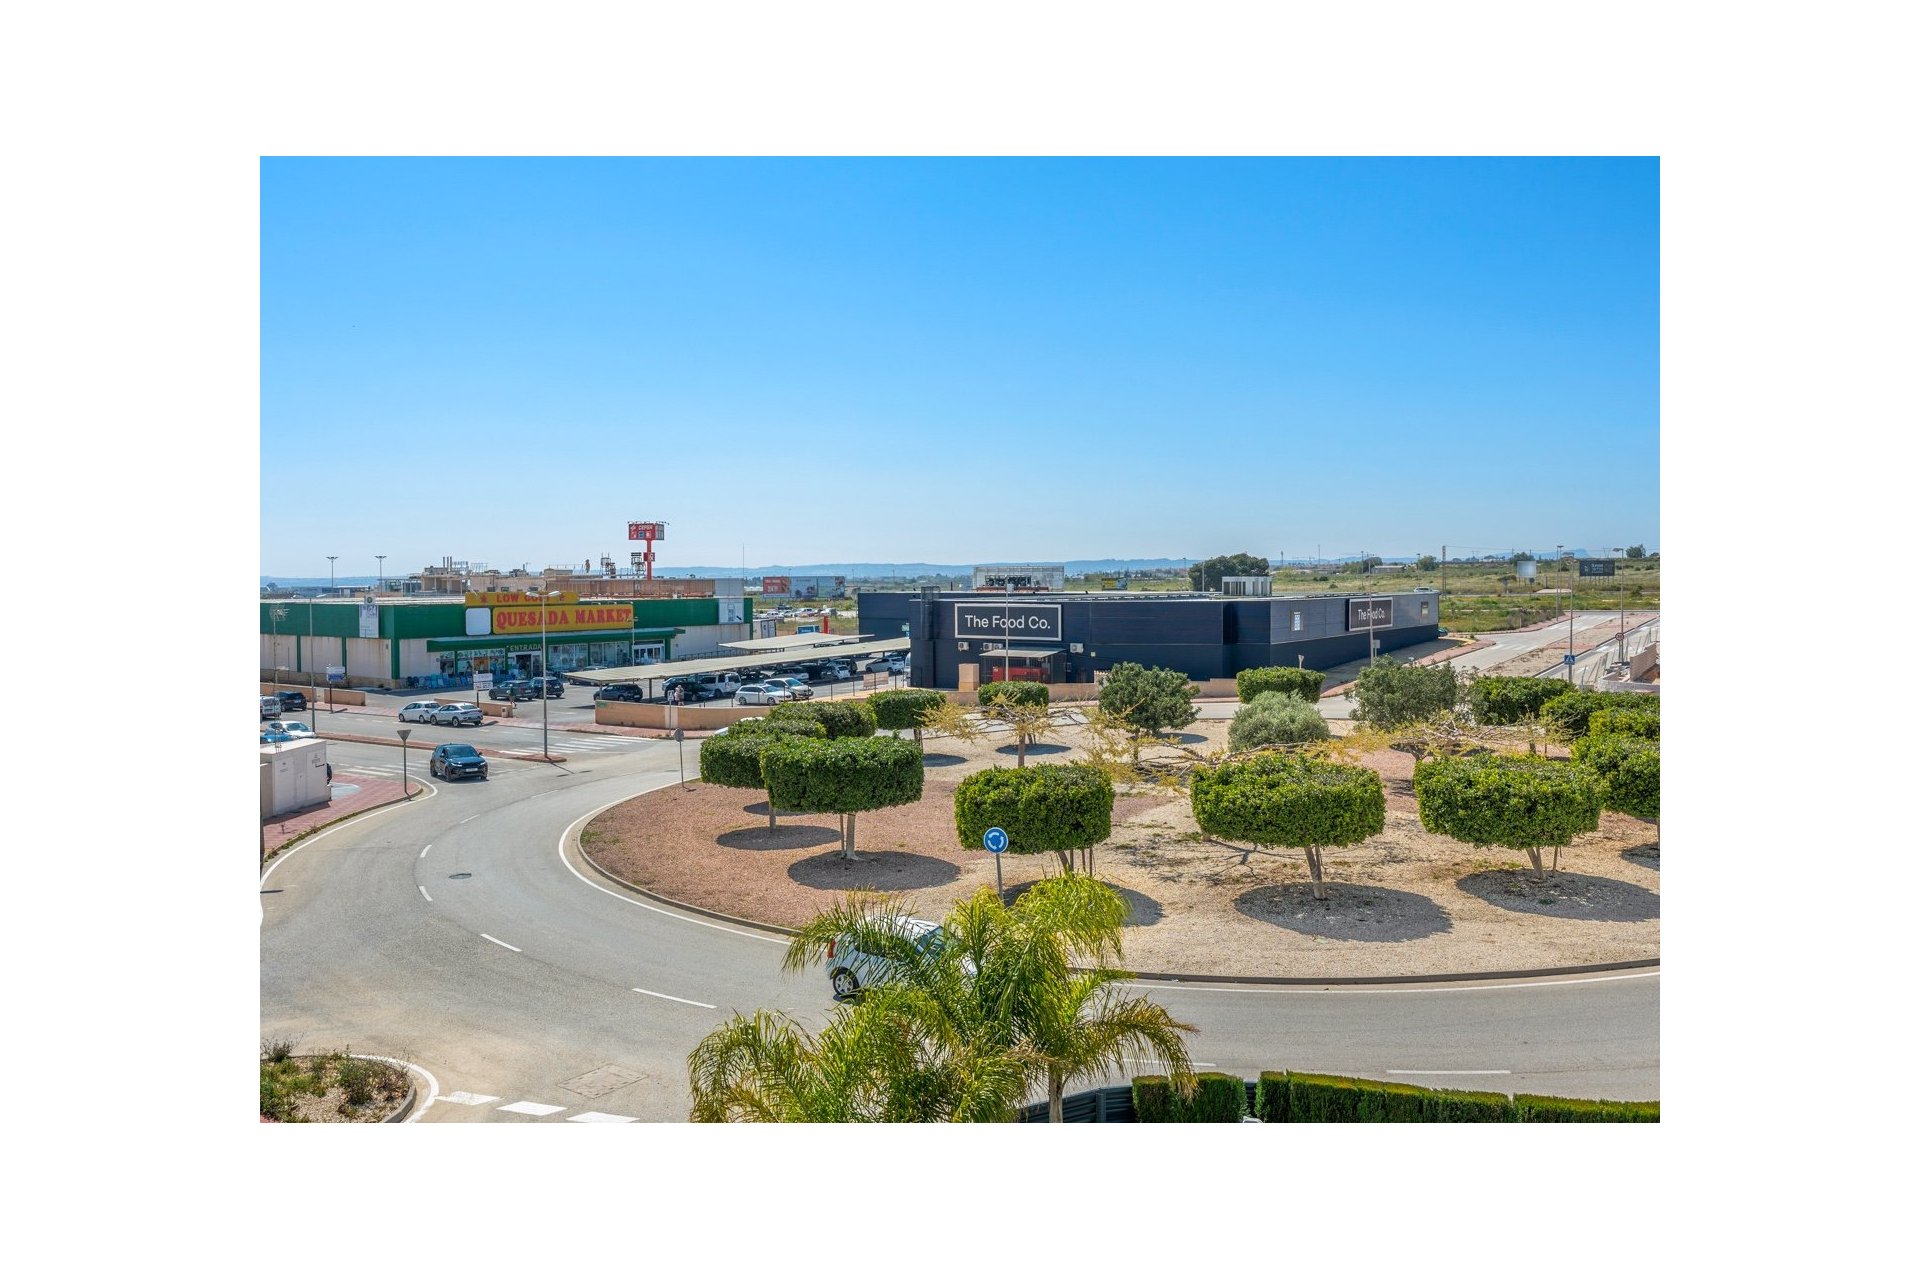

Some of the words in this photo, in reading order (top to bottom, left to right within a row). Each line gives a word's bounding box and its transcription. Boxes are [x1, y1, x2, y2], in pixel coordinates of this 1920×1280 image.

[497, 593, 519, 603] LOW
[497, 609, 569, 629] QUESADA
[575, 608, 632, 623] MARKET
[1358, 609, 1366, 620] The
[964, 615, 989, 628] The
[992, 615, 1024, 628] Food
[1028, 616, 1051, 629] Co.
